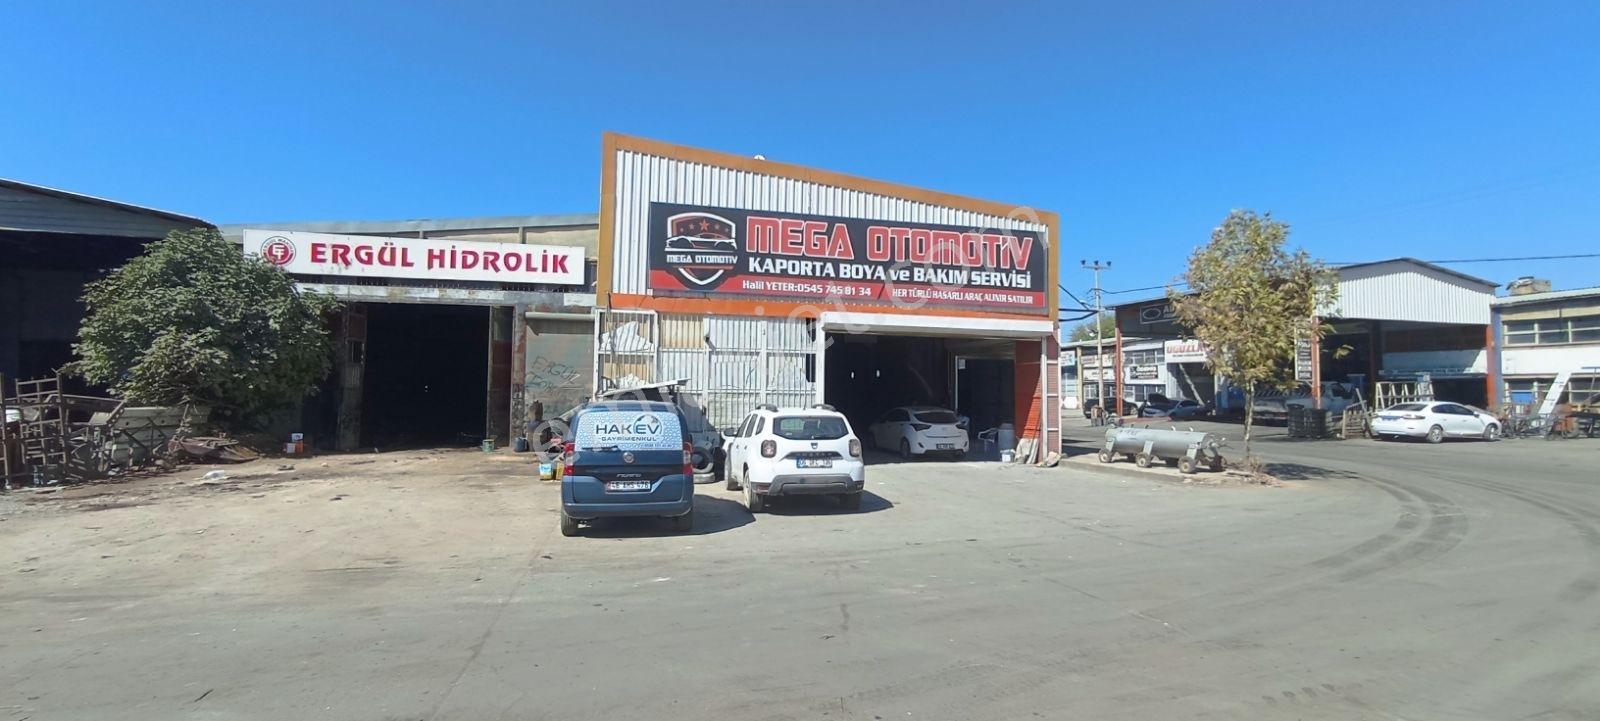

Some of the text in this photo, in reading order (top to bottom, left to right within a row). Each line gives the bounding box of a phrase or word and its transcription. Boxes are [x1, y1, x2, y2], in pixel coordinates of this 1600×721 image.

[746, 216, 855, 260] MEGA
[310, 241, 414, 267] ERGÜL
[427, 245, 569, 274] HİDROLİK
[666, 254, 693, 264] MEGA
[749, 257, 1032, 289] KAPORTA BOYA ve BAKIM SERVİSİ
[742, 280, 764, 290] Halil
[825, 285, 843, 295] 745
[844, 286, 856, 296] 81
[858, 287, 872, 296] 34
[892, 288, 908, 298] HER
[908, 288, 932, 299] TÜRLÜ
[932, 291, 964, 301] HASARLI
[964, 292, 984, 303] ARAÇ
[595, 423, 661, 435] HAKEV
